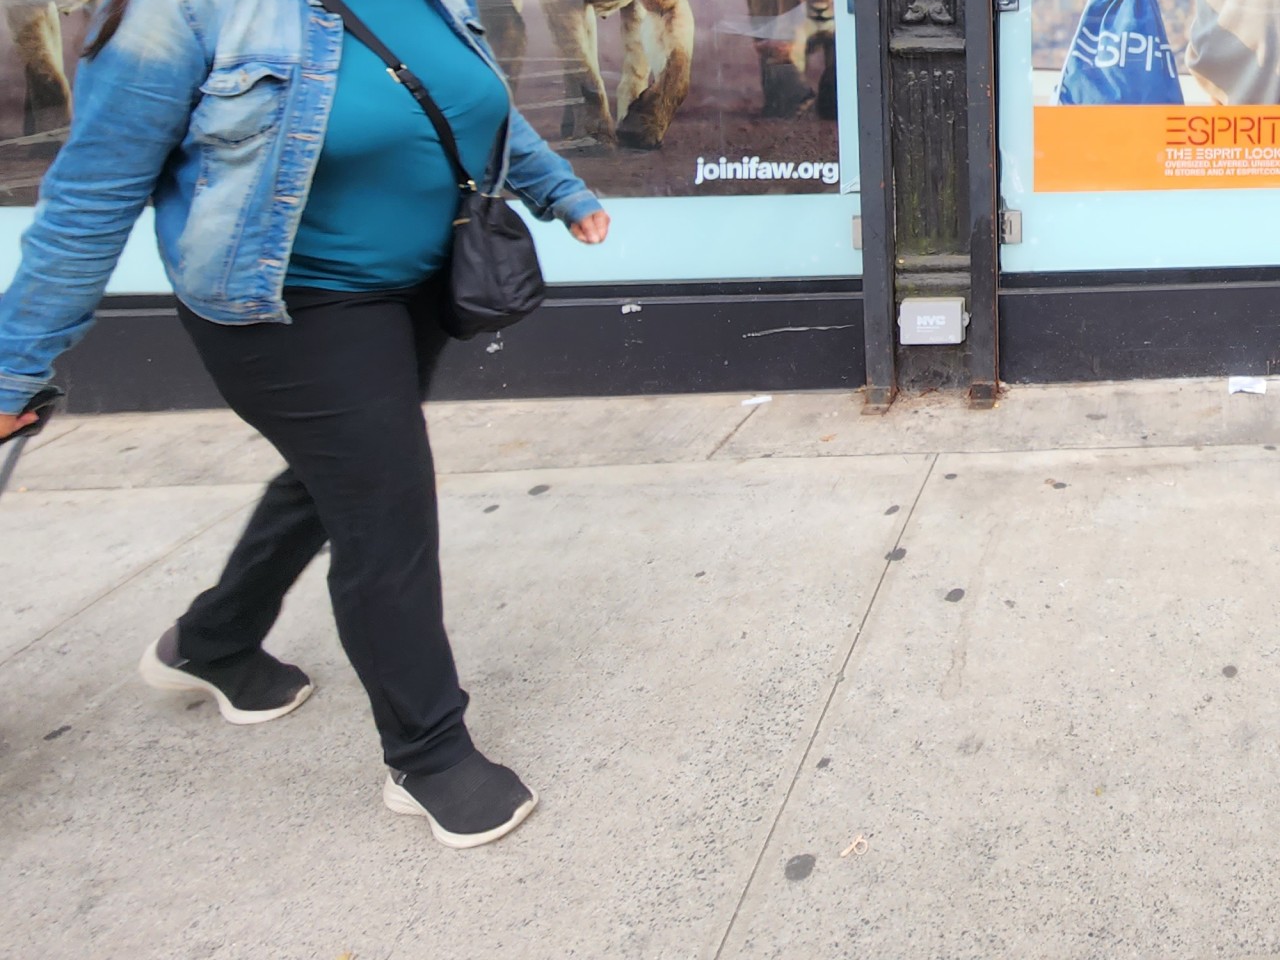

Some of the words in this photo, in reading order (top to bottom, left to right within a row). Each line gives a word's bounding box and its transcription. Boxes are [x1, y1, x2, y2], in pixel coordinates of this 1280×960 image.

[1165, 148, 1192, 160] THE
[1196, 147, 1242, 160] ESPRIT
[694, 155, 840, 185] joinifaw.org
[1207, 168, 1224, 176] AND
